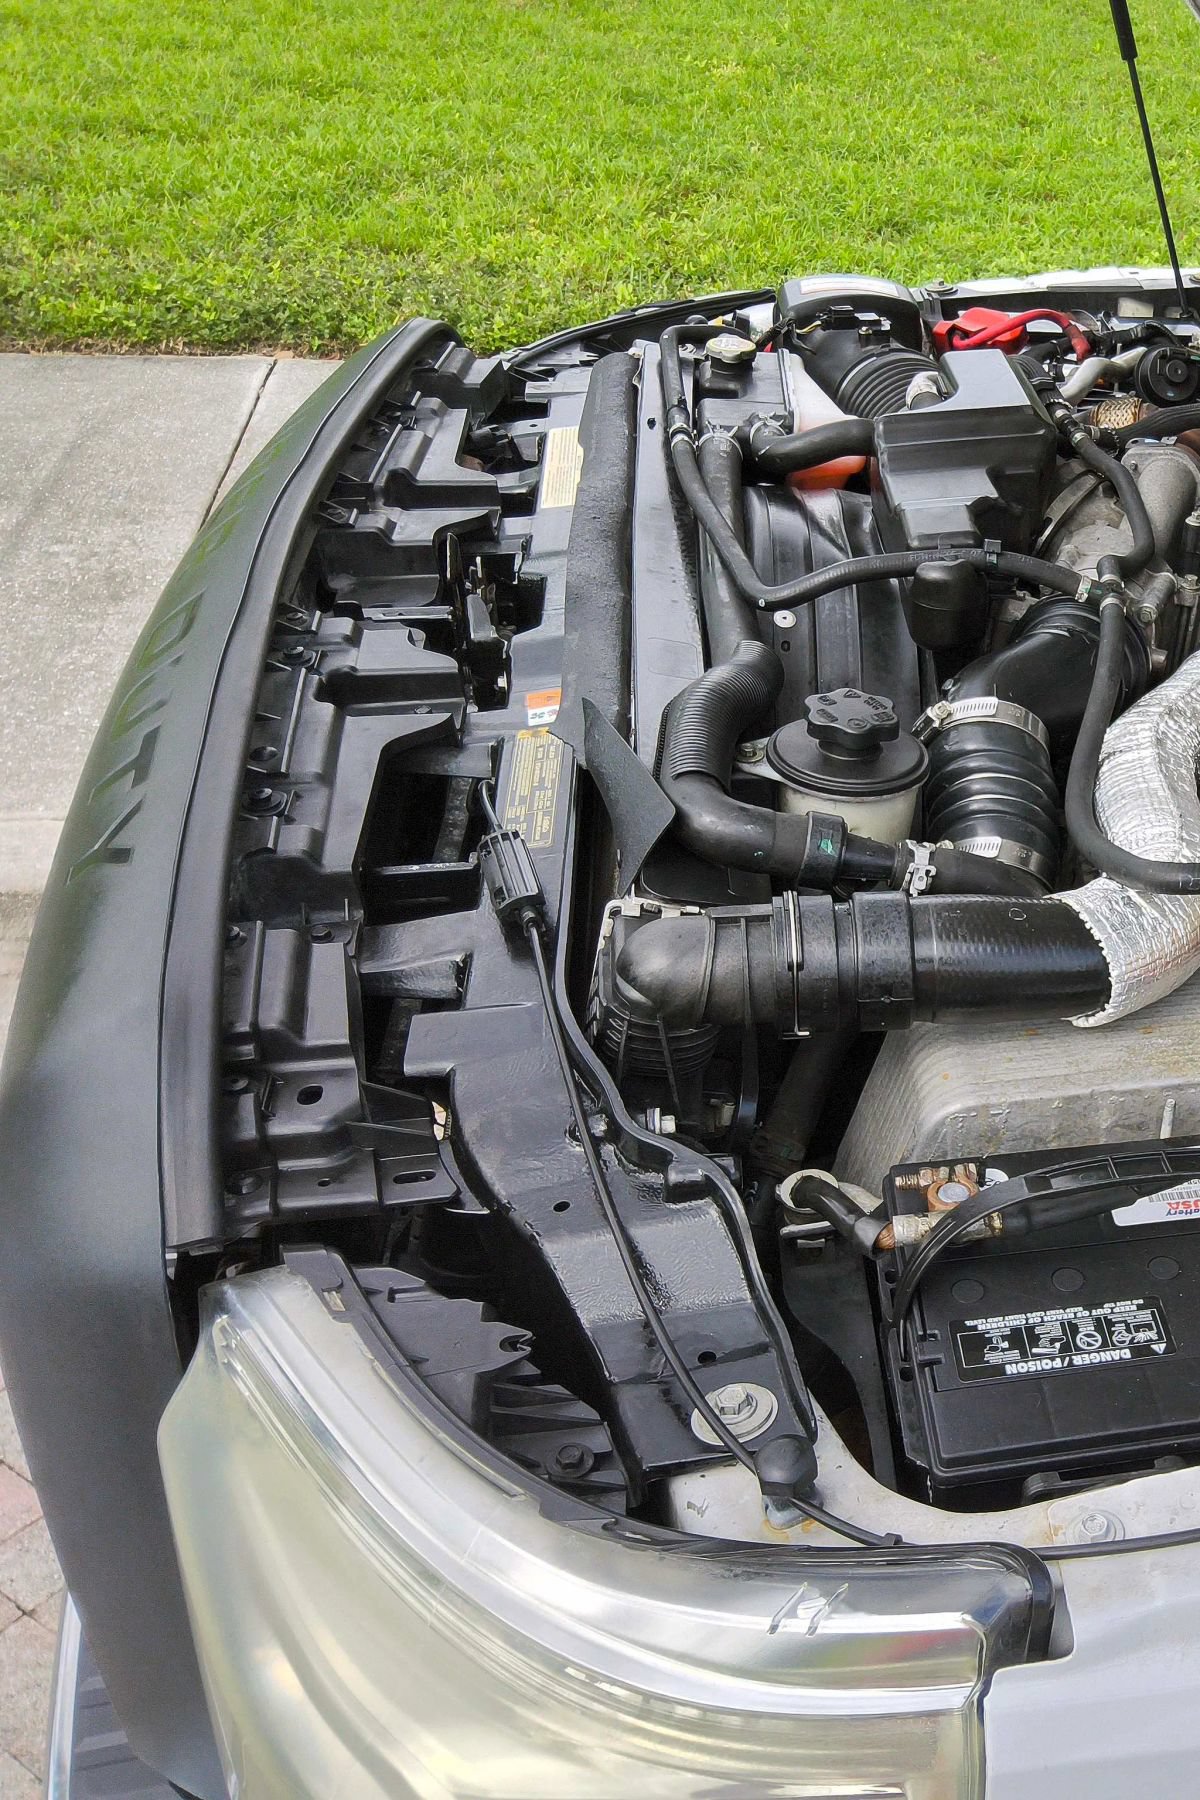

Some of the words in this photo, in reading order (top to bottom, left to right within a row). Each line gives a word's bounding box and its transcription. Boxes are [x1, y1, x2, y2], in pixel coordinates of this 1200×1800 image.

[1091, 1308, 1112, 1316] OUT
[1113, 1305, 1137, 1313] KEEP
[1027, 1316, 1042, 1324] OF
[1043, 1313, 1075, 1322] REACH
[977, 1319, 1026, 1331] CHILDREN
[1071, 1348, 1132, 1366] DANGER
